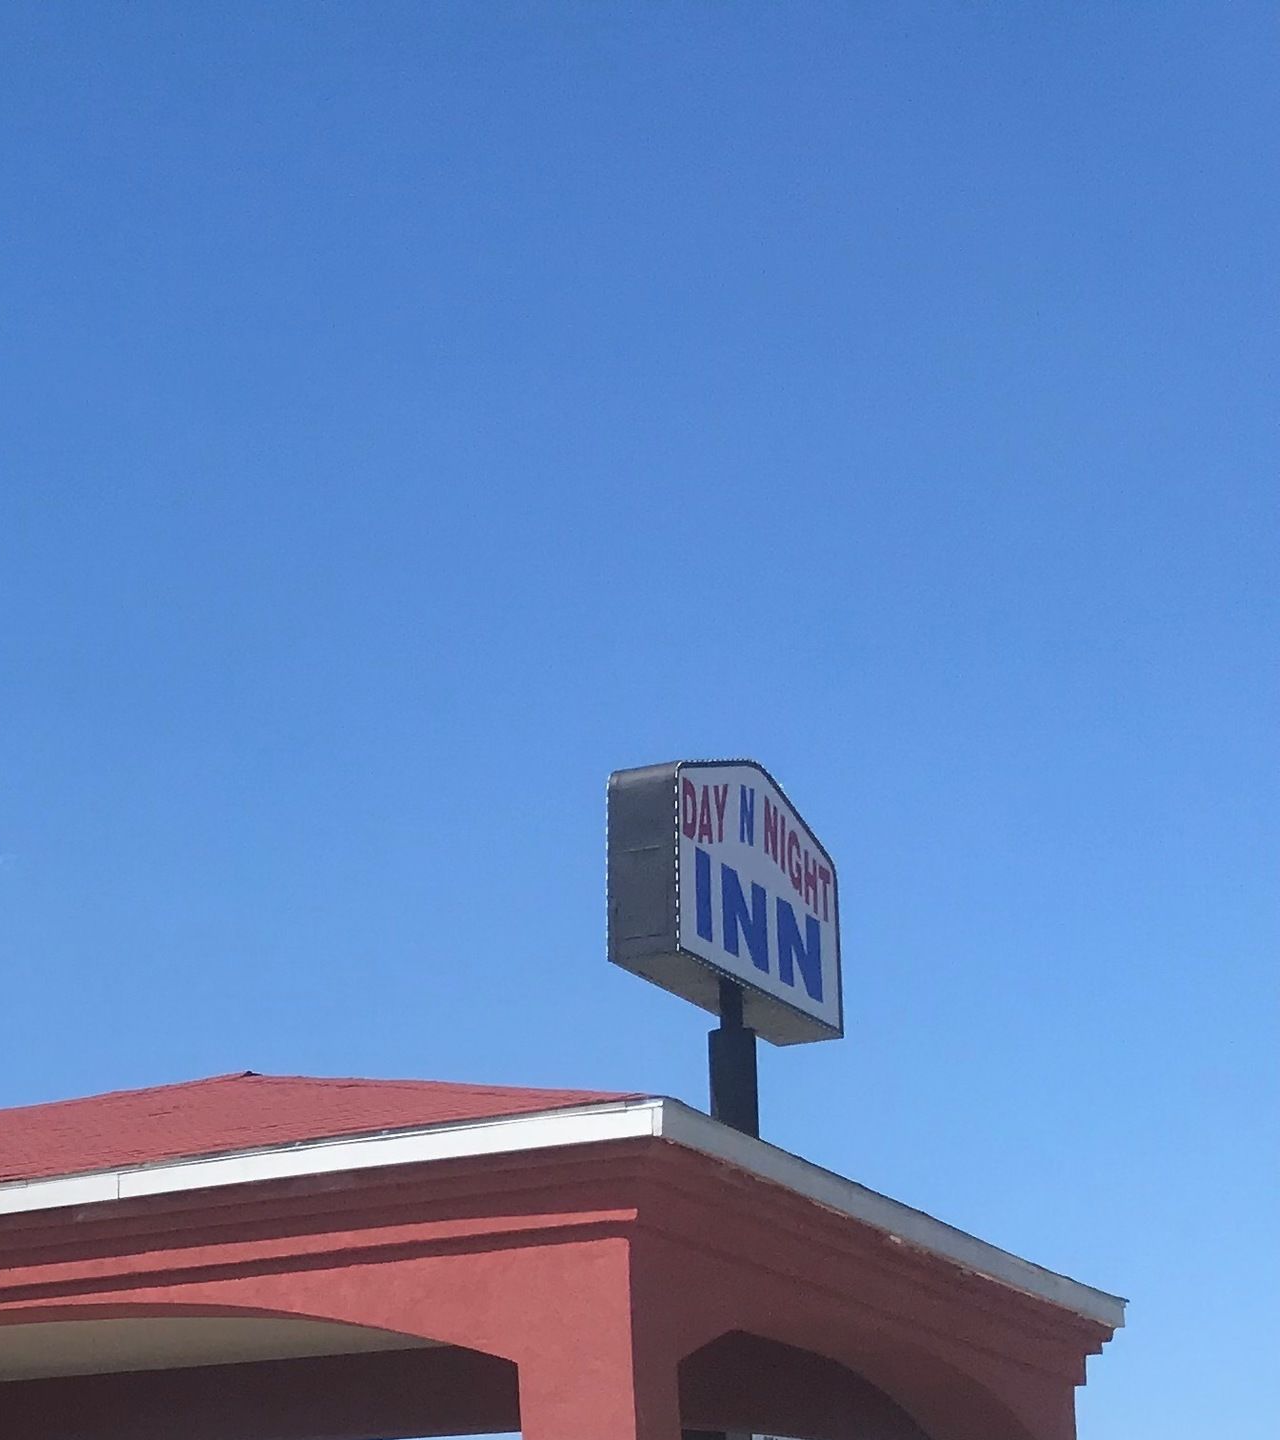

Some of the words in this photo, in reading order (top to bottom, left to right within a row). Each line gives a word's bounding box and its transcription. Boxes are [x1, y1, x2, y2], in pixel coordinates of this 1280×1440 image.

[682, 777, 729, 844] DAY
[740, 784, 755, 847] N
[764, 795, 831, 923] NIGHT
[695, 847, 824, 1004] INN
